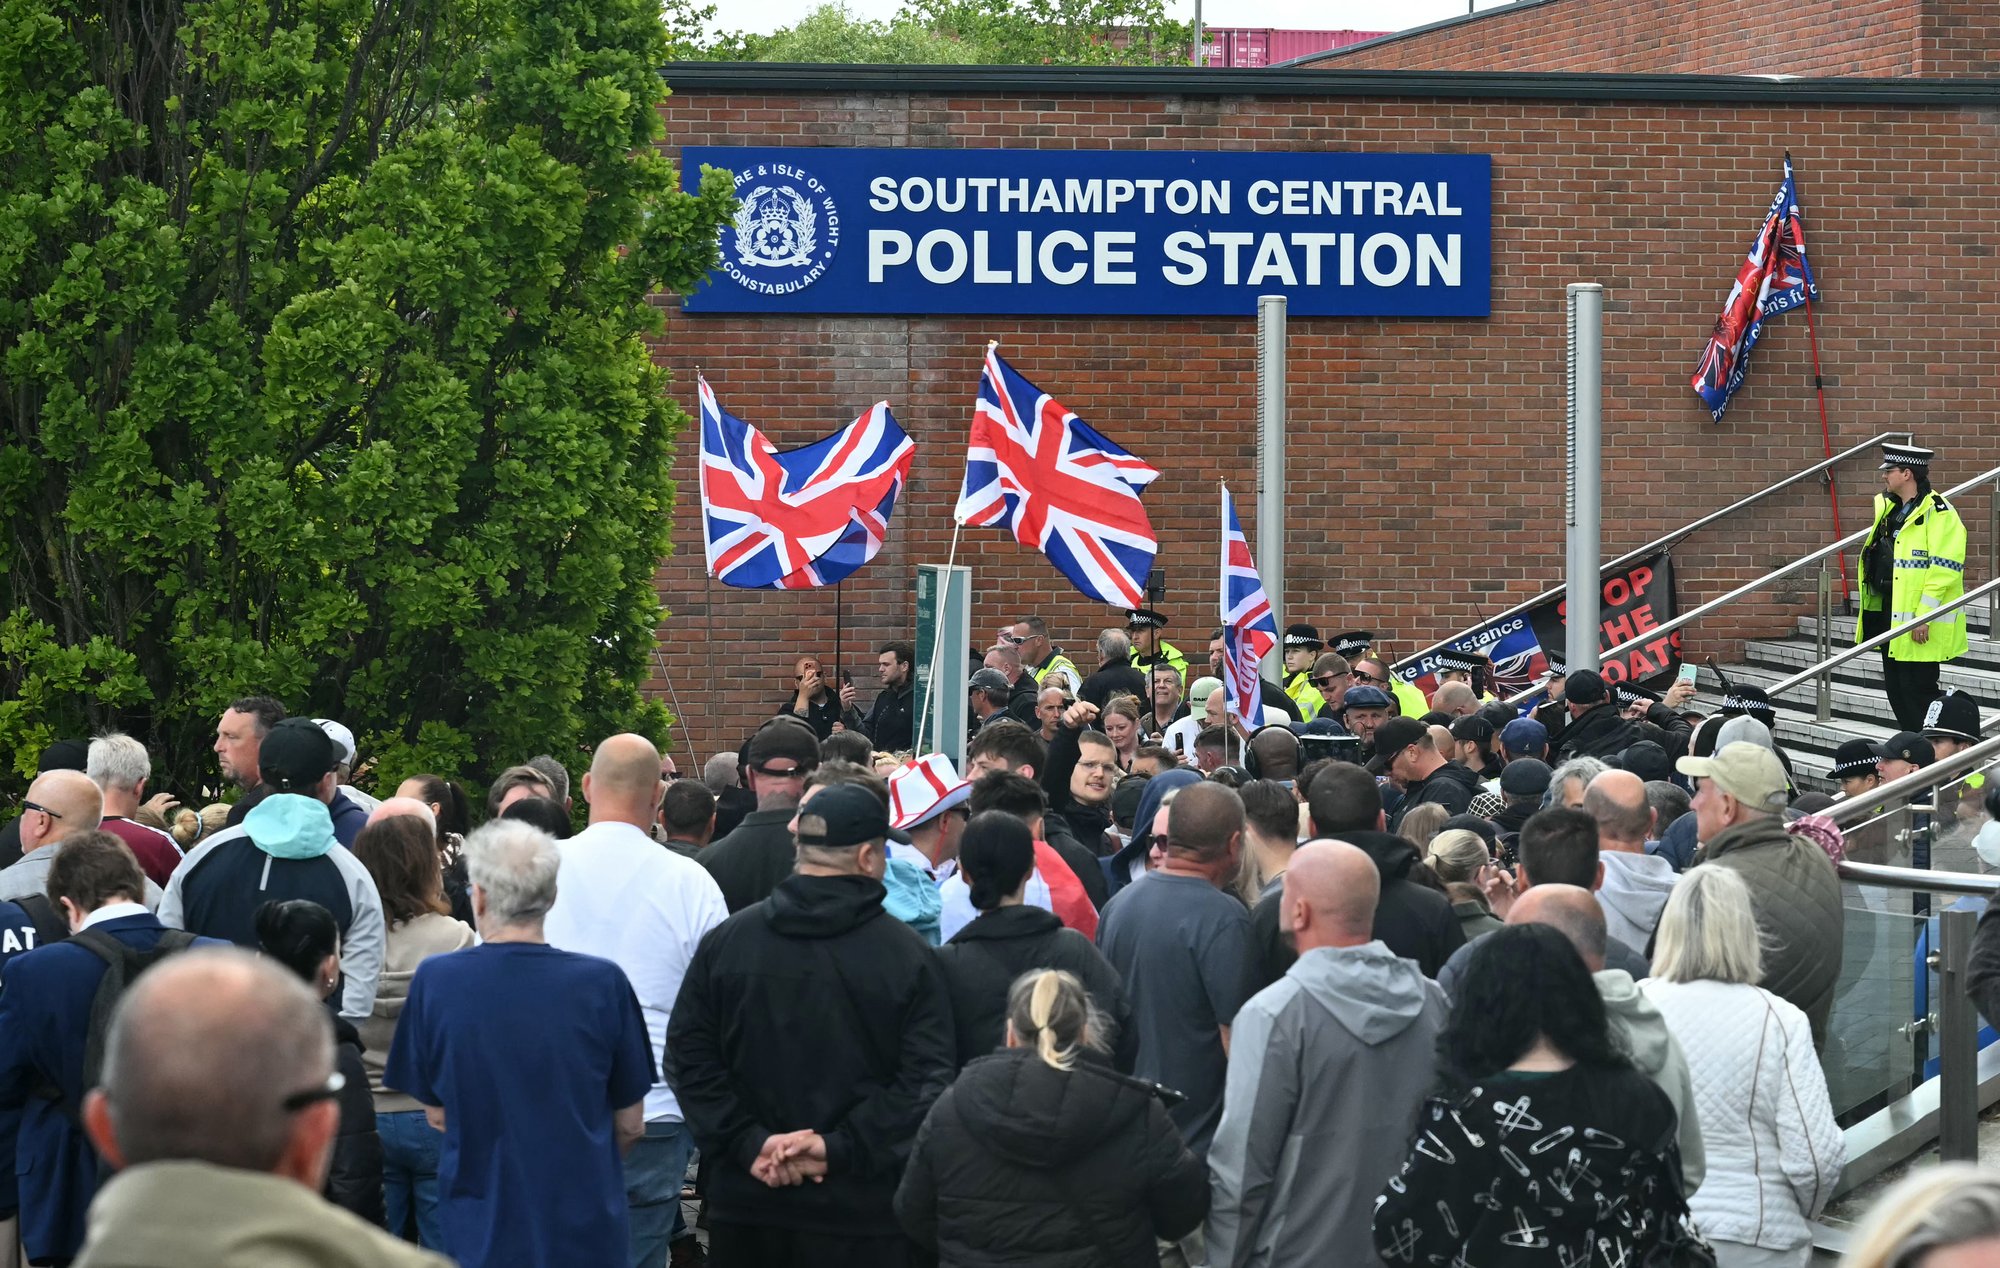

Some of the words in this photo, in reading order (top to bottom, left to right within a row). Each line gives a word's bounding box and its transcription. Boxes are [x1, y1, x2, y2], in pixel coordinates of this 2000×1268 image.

[772, 164, 805, 181] ISLE
[807, 178, 826, 194] OF
[823, 197, 839, 247] WIGHT
[868, 176, 1231, 215] SOUTHAMPTON
[1247, 179, 1462, 216] CENTRAL
[723, 261, 826, 295] CONSTABULARY
[868, 229, 1137, 286] POLICE
[1161, 230, 1462, 287] STATION
[1420, 618, 1524, 673] Reistance
